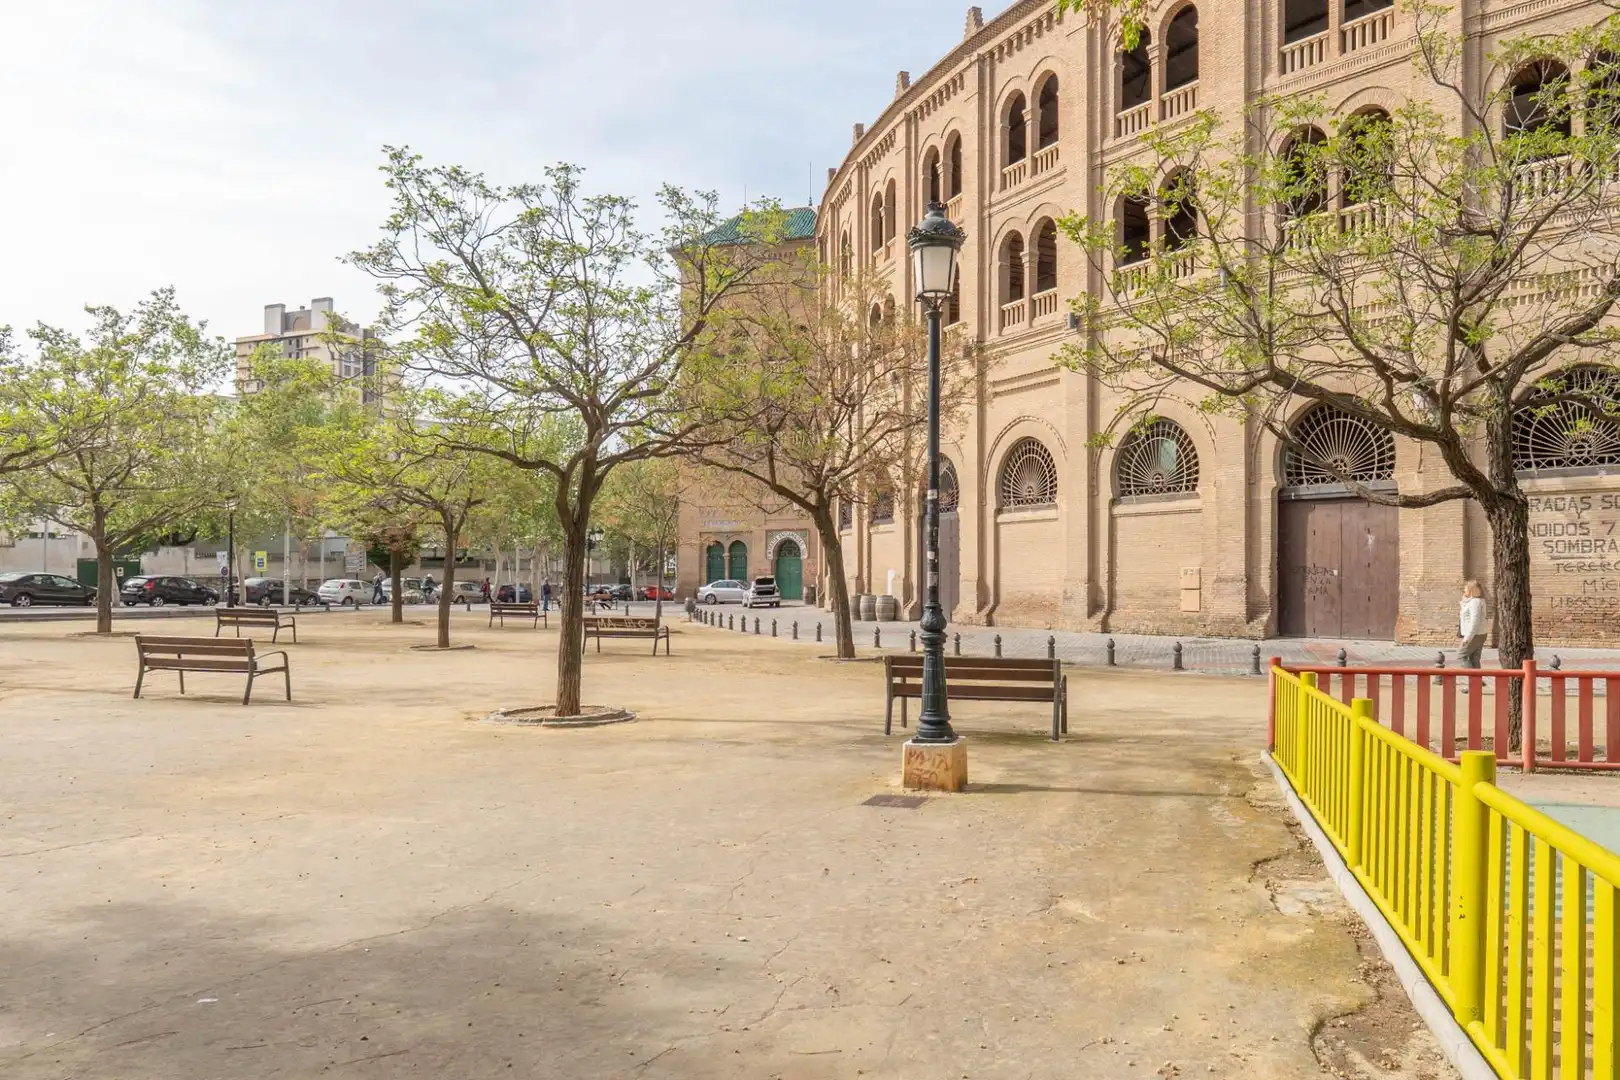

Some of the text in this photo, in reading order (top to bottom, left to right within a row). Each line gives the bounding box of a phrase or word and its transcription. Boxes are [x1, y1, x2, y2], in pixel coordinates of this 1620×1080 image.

[1529, 496, 1592, 512] RADAS
[1576, 510, 1583, 519] Y
[1528, 520, 1616, 537] NDIDOS 7
[1543, 538, 1618, 554] SOMBRA
